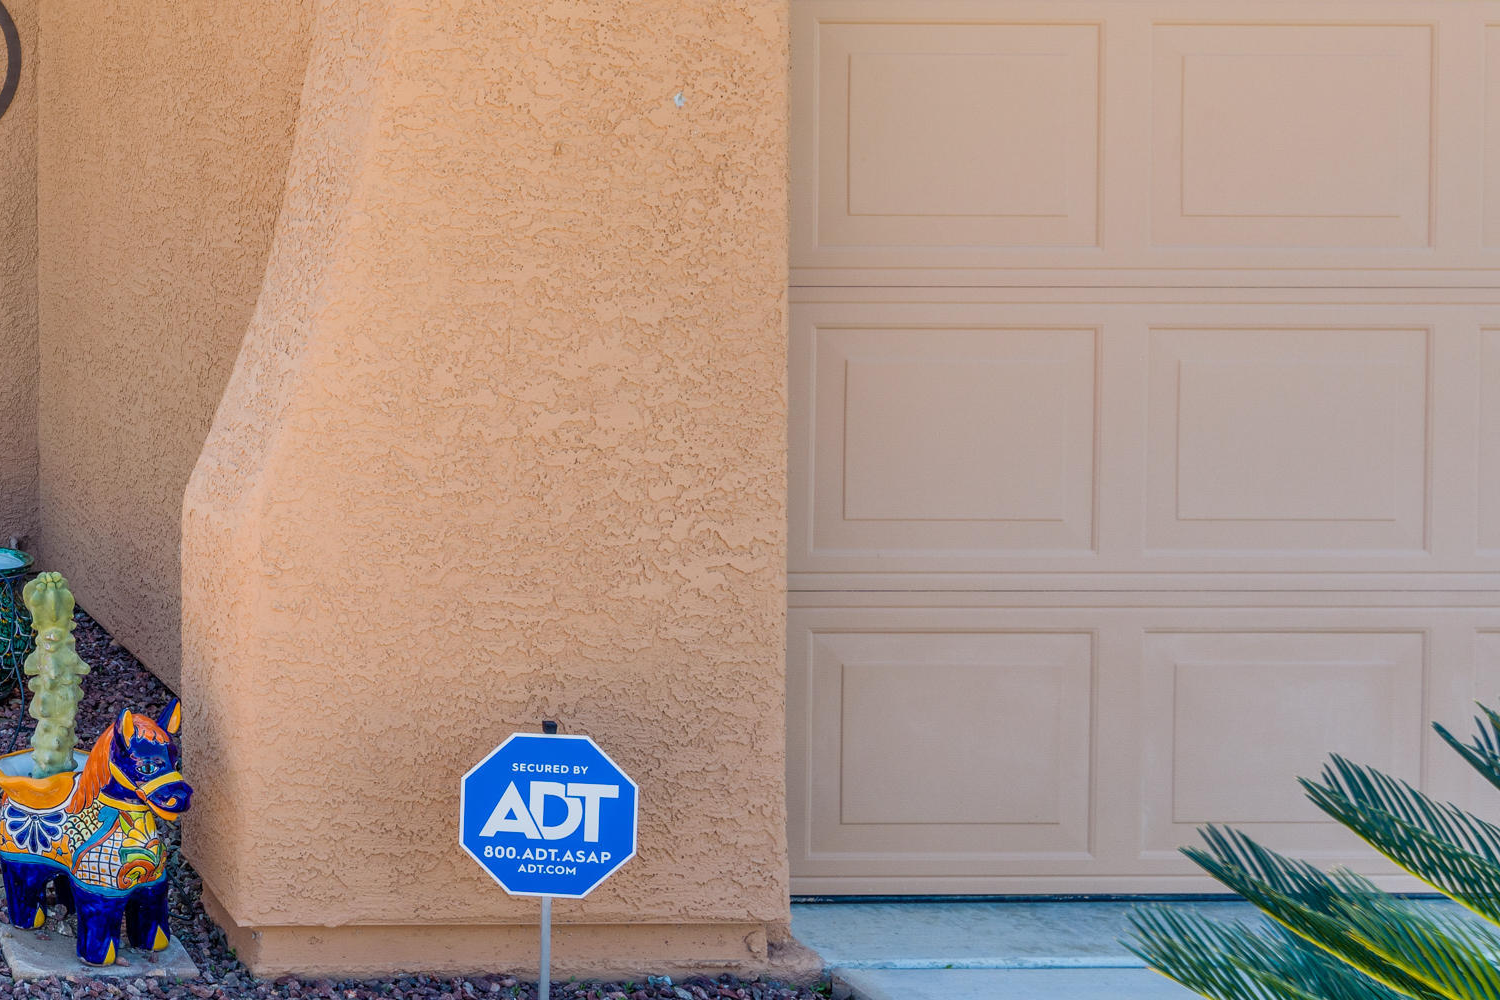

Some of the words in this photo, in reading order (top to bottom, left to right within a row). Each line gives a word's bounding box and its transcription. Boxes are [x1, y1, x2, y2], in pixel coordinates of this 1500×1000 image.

[511, 762, 570, 775] SECURED
[573, 765, 589, 775] BY
[478, 780, 620, 843] ADT
[483, 845, 612, 865] 800.ADT.ASAP
[517, 863, 577, 876] ADT.COM
